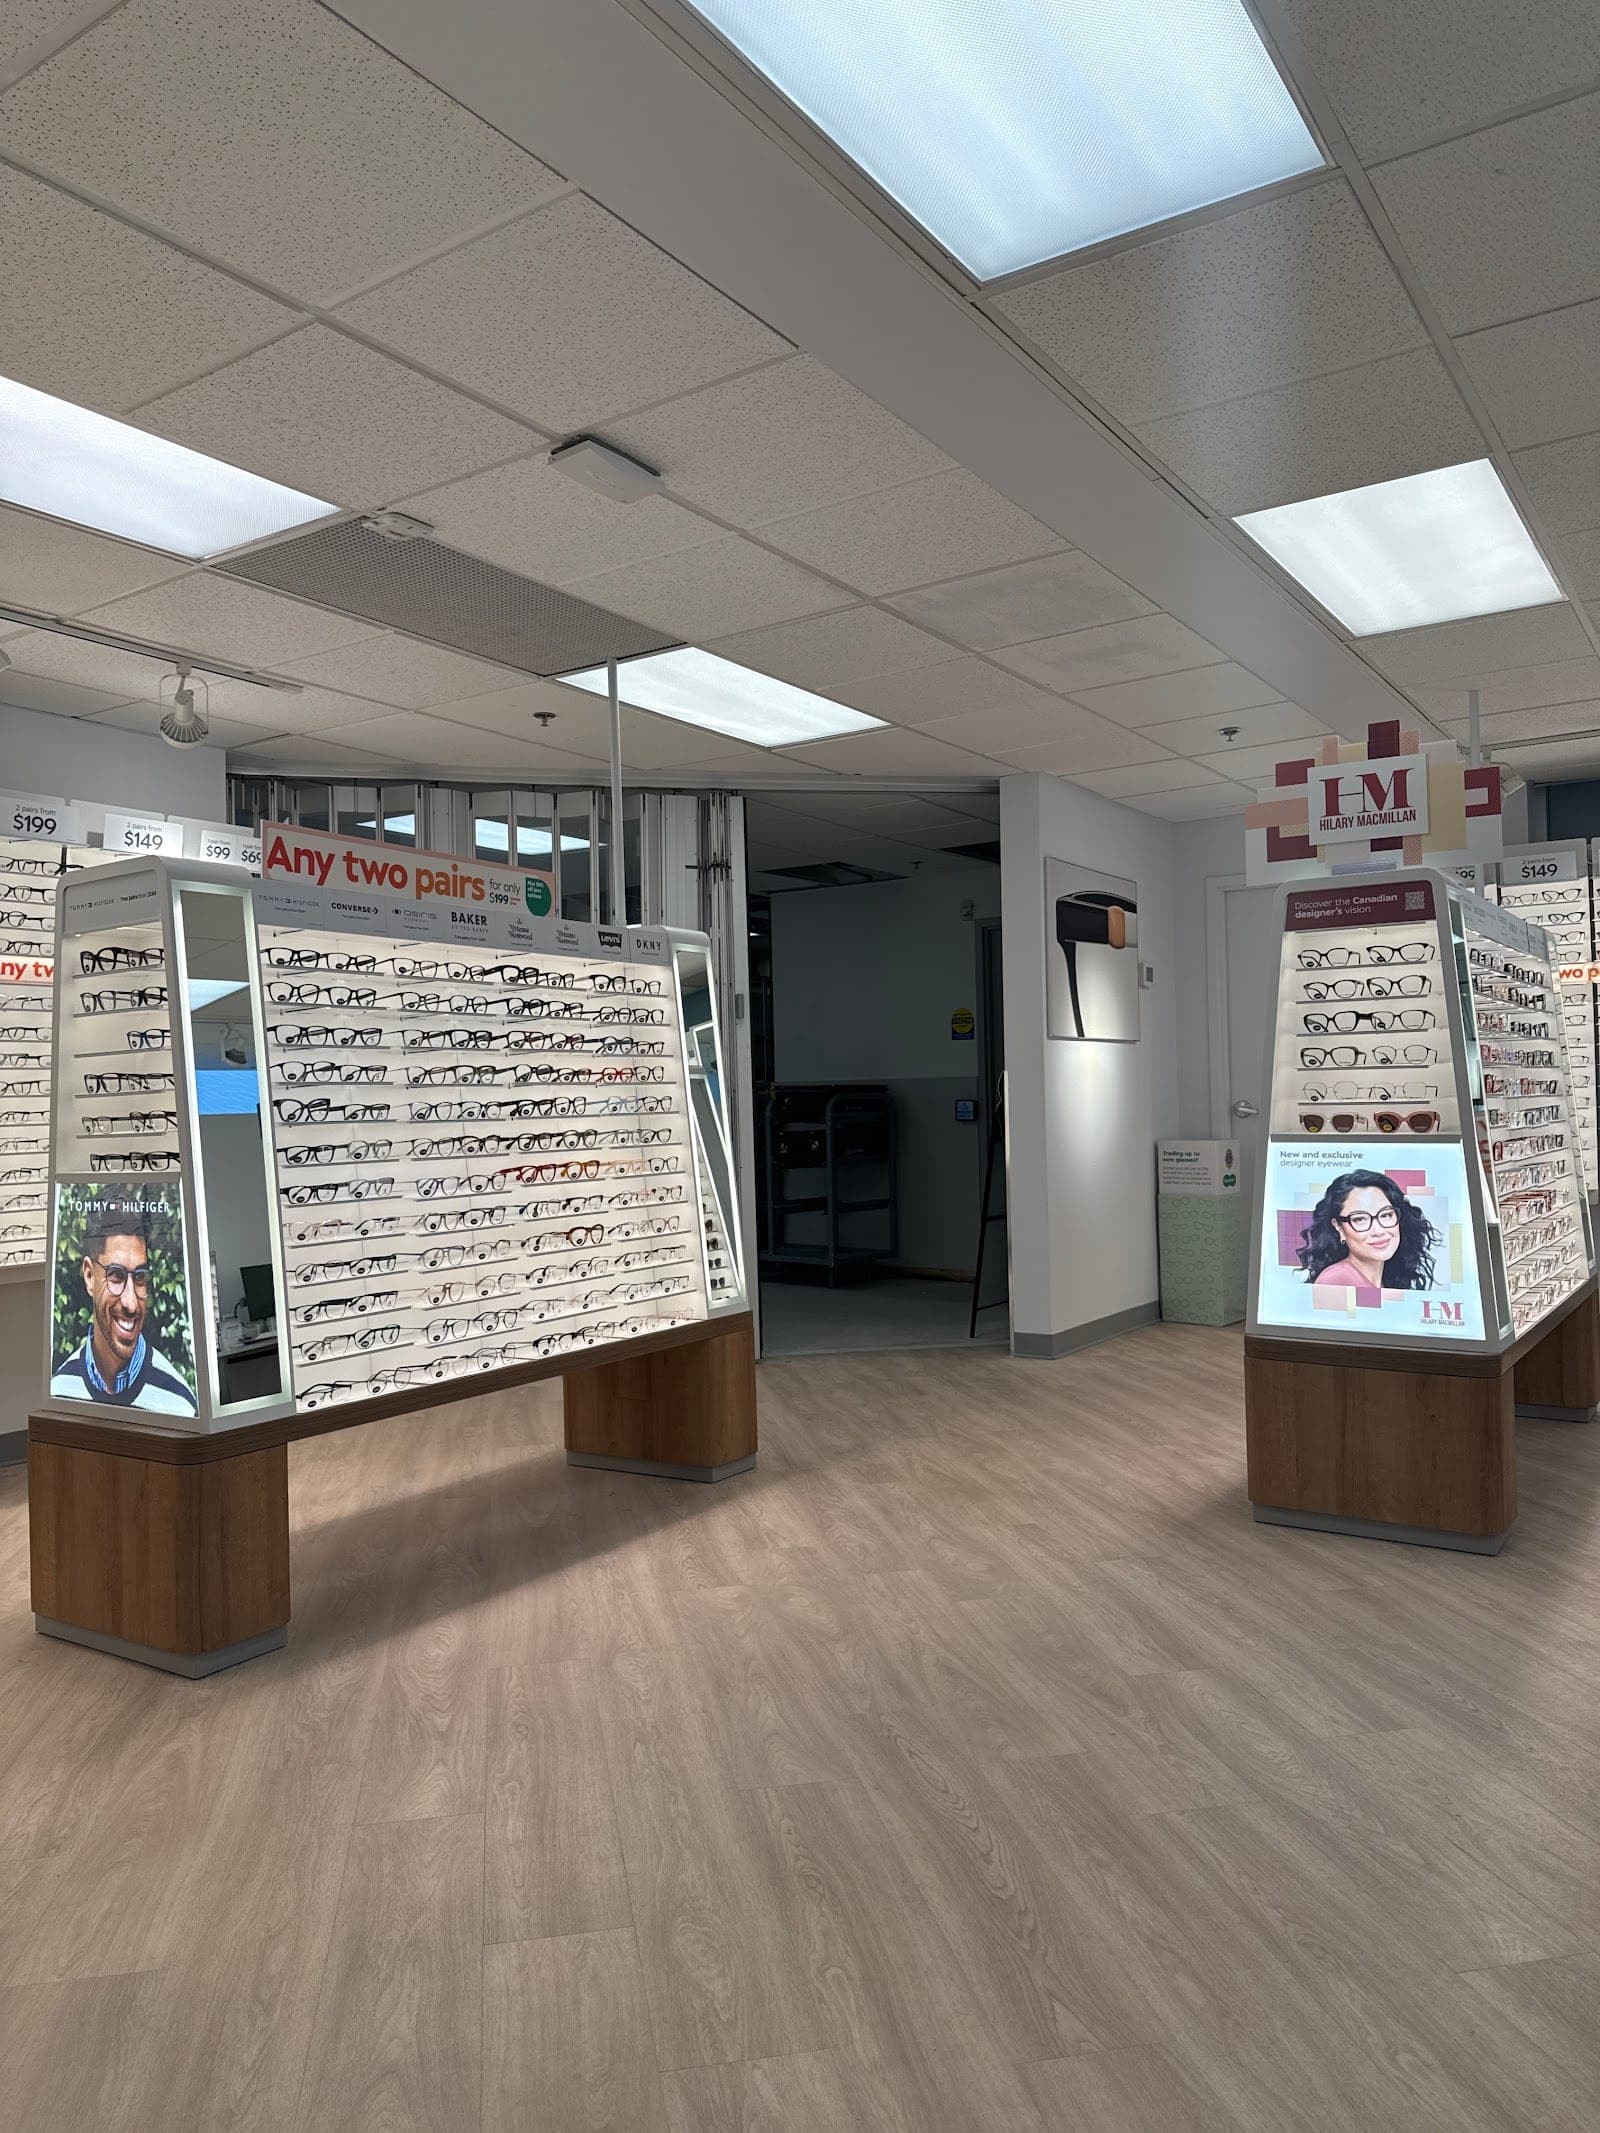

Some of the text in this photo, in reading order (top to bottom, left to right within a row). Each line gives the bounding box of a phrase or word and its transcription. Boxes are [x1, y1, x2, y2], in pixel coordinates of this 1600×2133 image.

[22, 805, 38, 815] pairs
[40, 807, 56, 816] from
[13, 813, 57, 835] $199
[126, 821, 163, 833] 2 pairs from
[1320, 809, 1416, 831] HILARY MACMILLAN
[124, 829, 163, 850] $149
[206, 844, 231, 860] $99
[267, 836, 485, 901] Any two pairs
[1521, 863, 1558, 879] $149
[489, 878, 521, 896] for only
[489, 892, 509, 905] $199
[1295, 893, 1398, 910] Discover the Canadian
[331, 902, 372, 914] CONVERSE
[1295, 905, 1371, 919] designer's vision
[451, 911, 488, 926] BAKER
[636, 938, 662, 951] DKNY
[0, 962, 28, 981] ny
[1558, 968, 1583, 979] wo
[1302, 1150, 1319, 1158] and
[1321, 1150, 1364, 1159] exclusive
[1280, 1159, 1352, 1168] designer eyewear
[70, 1200, 170, 1213] TOMMY HILFIGER
